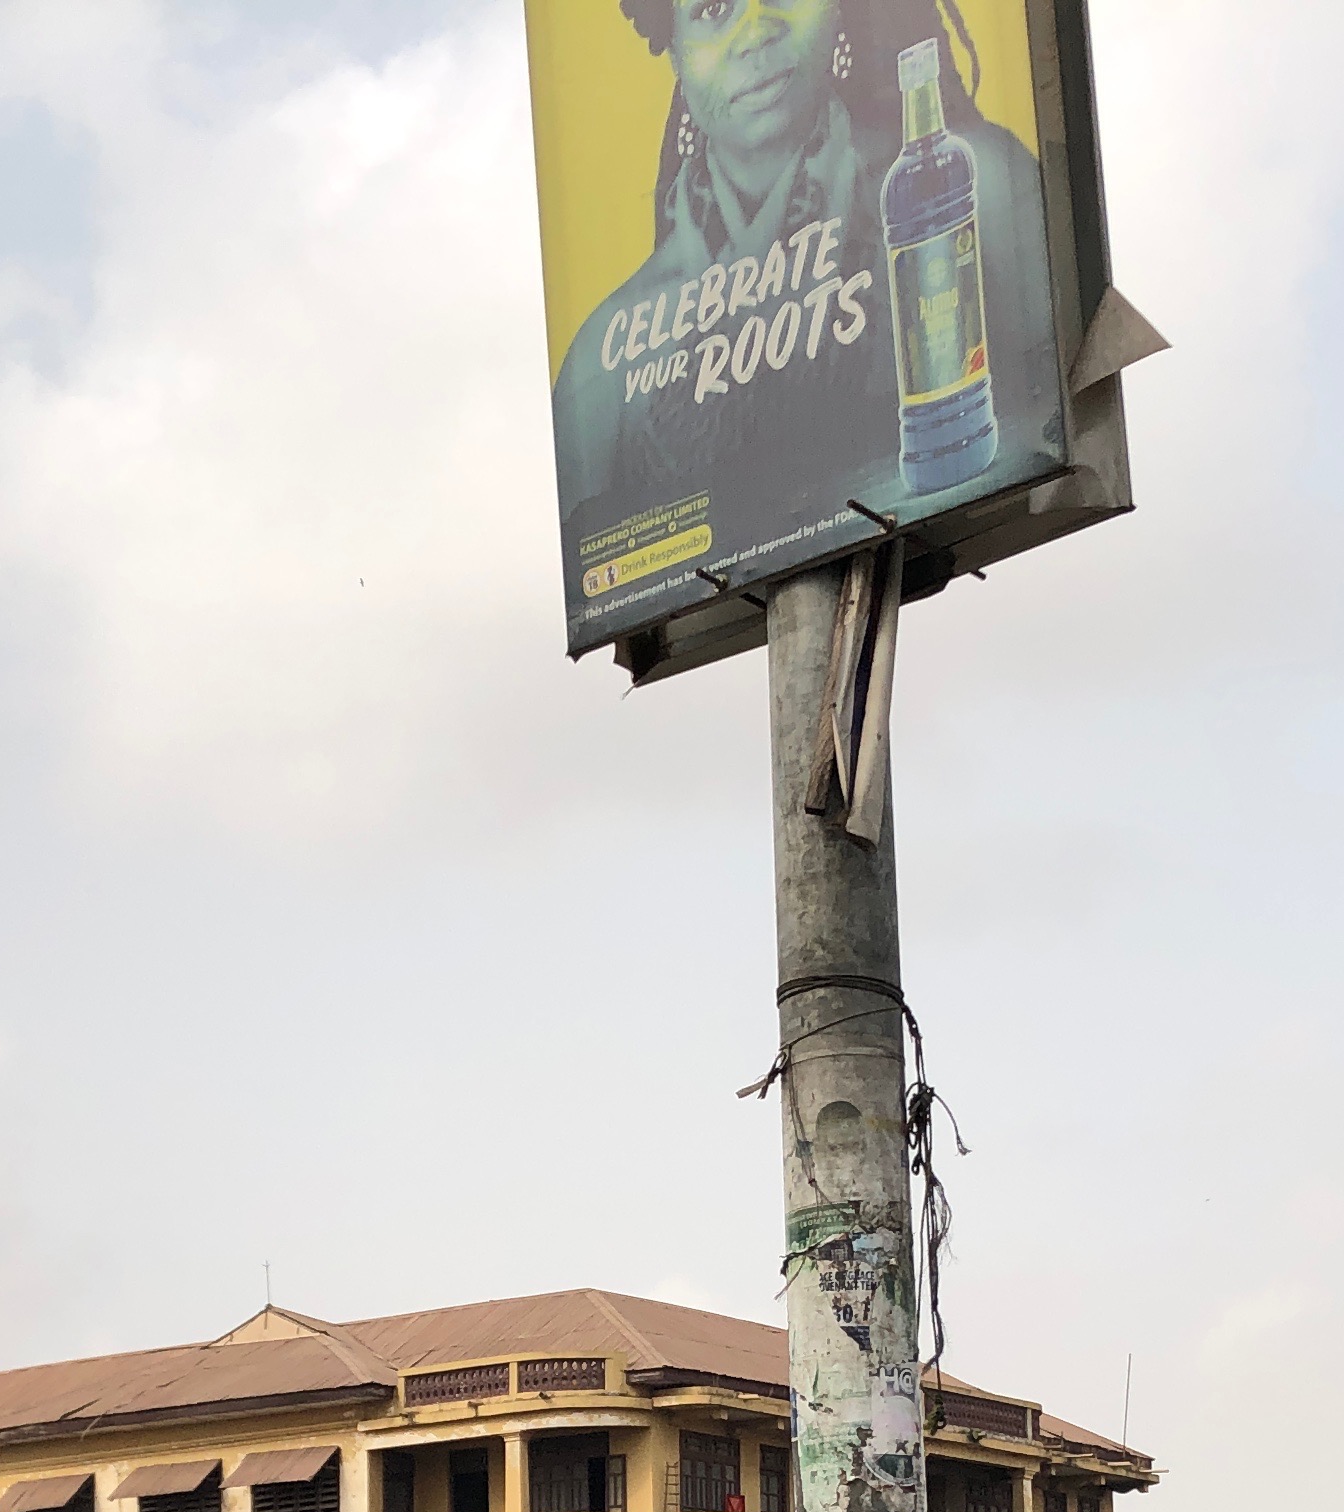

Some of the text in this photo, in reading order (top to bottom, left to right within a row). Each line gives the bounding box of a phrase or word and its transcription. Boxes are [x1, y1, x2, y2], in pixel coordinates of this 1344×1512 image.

[601, 219, 842, 371] CELEBRATE
[625, 269, 873, 404] YOUR ROOTS
[621, 556, 648, 576] Drink
[649, 533, 709, 564] Responsibly
[630, 511, 673, 535] COMPANY
[673, 496, 710, 518] LIMITED
[584, 606, 603, 620] This
[604, 580, 666, 613] advertisement
[667, 575, 683, 588] has
[709, 554, 737, 573] vetted
[739, 544, 757, 560] and
[757, 528, 803, 555] approved
[803, 522, 816, 537] by
[817, 517, 834, 531] the
